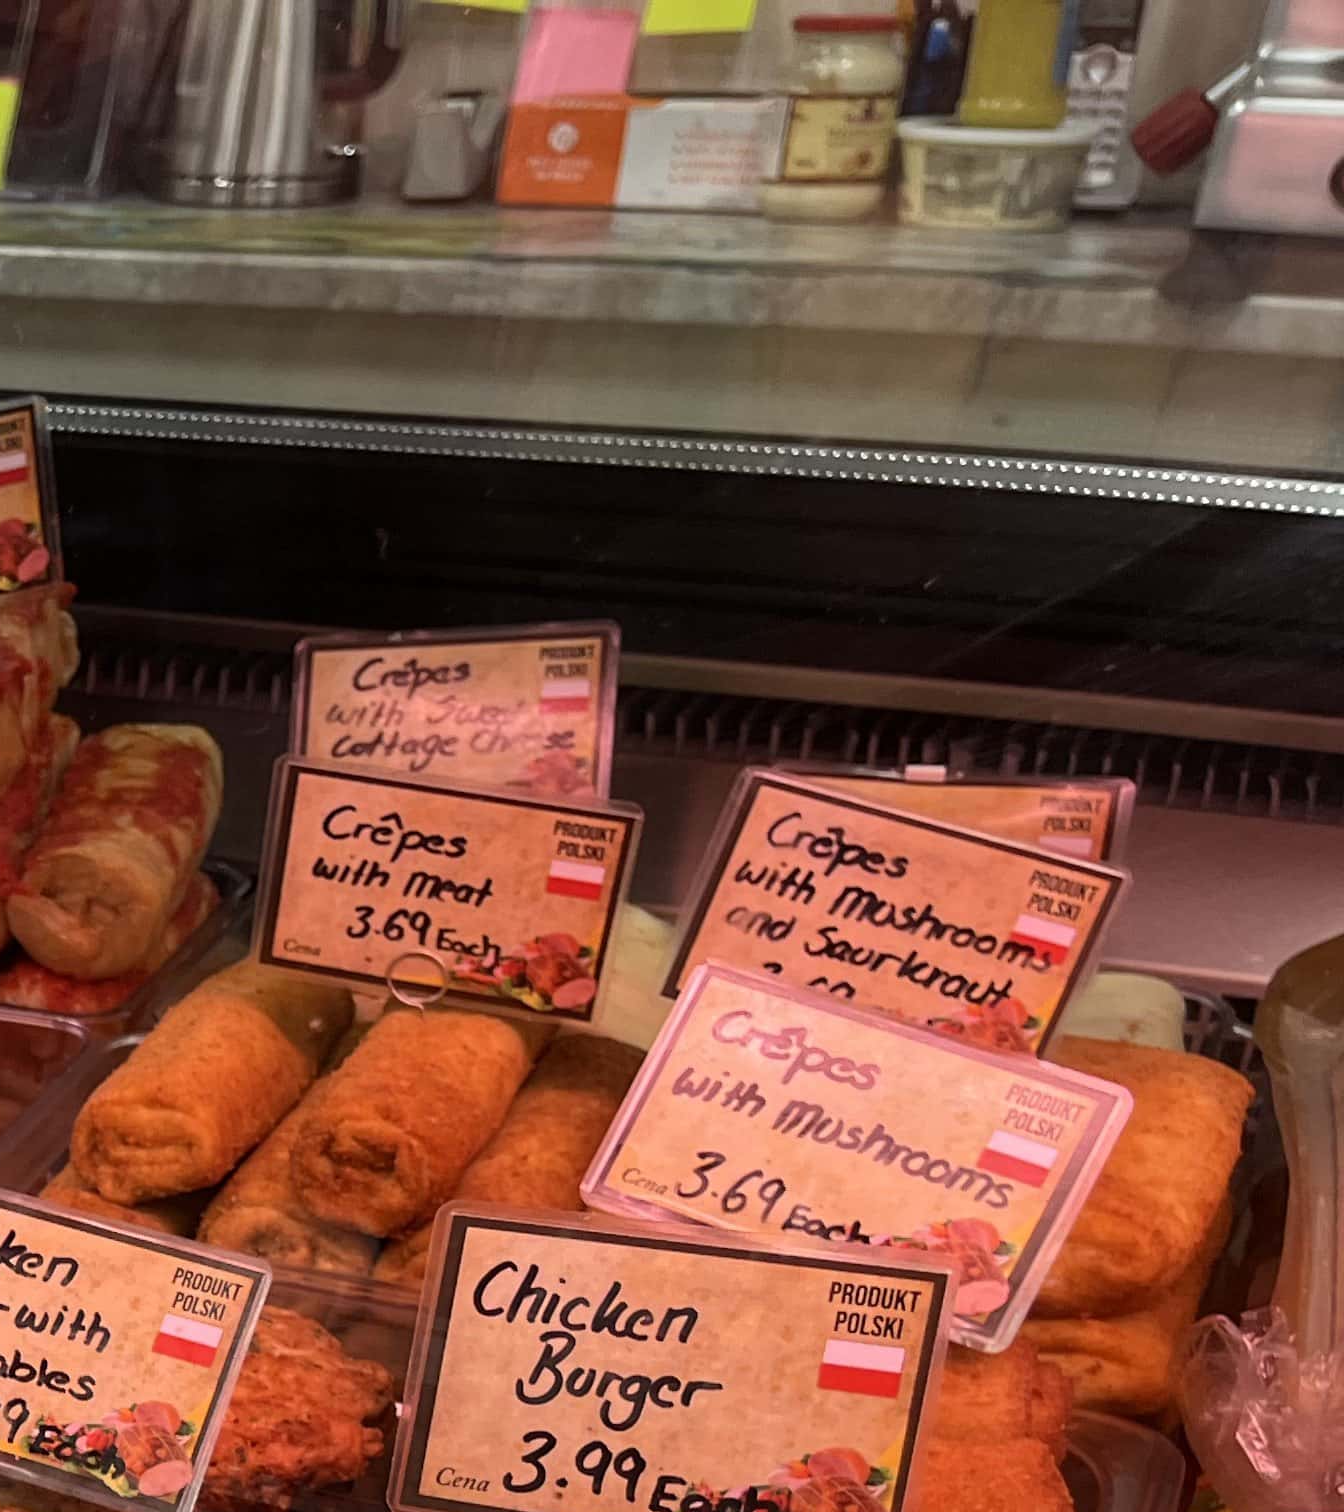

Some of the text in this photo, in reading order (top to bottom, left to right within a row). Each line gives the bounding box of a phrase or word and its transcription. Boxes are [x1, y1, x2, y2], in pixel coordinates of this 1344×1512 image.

[324, 701, 404, 728] with
[323, 805, 468, 862] Crêpes
[553, 820, 617, 844] PRODUKT
[556, 840, 605, 862] POLSKI
[313, 857, 390, 888] with
[735, 860, 815, 904] with
[1029, 869, 1099, 902] PRODUKT
[726, 905, 795, 941] and
[1026, 892, 1080, 921] POLSKI
[346, 906, 432, 946] 3.69
[673, 1065, 766, 1118] with
[1005, 1085, 1086, 1120] PRODUKT
[1003, 1110, 1063, 1142] POLSKI
[622, 1167, 669, 1195] Cena
[675, 1150, 787, 1224] 3.69
[172, 1266, 243, 1302] PRODUKT
[829, 1281, 922, 1315] PRODUKT
[171, 1291, 225, 1322] POLSKI
[472, 1260, 699, 1345] Chicken
[14, 1302, 112, 1354] with
[833, 1309, 905, 1341] POLSKI
[515, 1330, 723, 1433] Burger
[435, 1465, 491, 1494] Cena
[502, 1430, 647, 1504] 3.99
